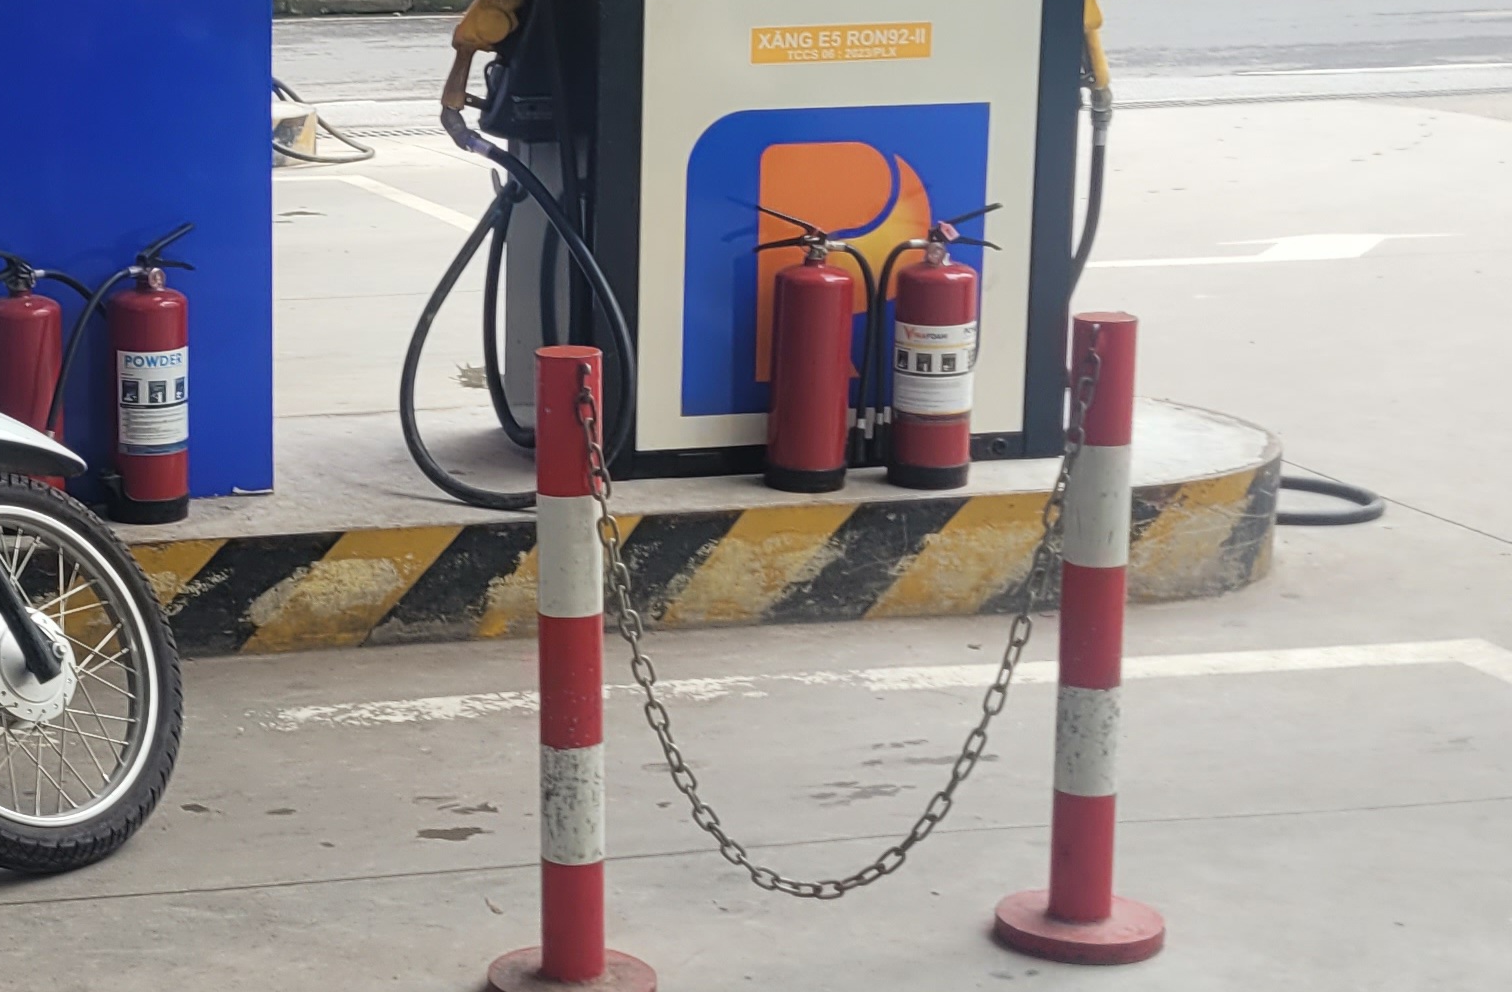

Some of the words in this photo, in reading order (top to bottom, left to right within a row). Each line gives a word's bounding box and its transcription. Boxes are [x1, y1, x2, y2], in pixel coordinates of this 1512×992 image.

[757, 27, 814, 50] XĂNG
[818, 31, 841, 49] E5
[846, 28, 926, 48] RON92-II
[124, 353, 183, 369] POWDER
